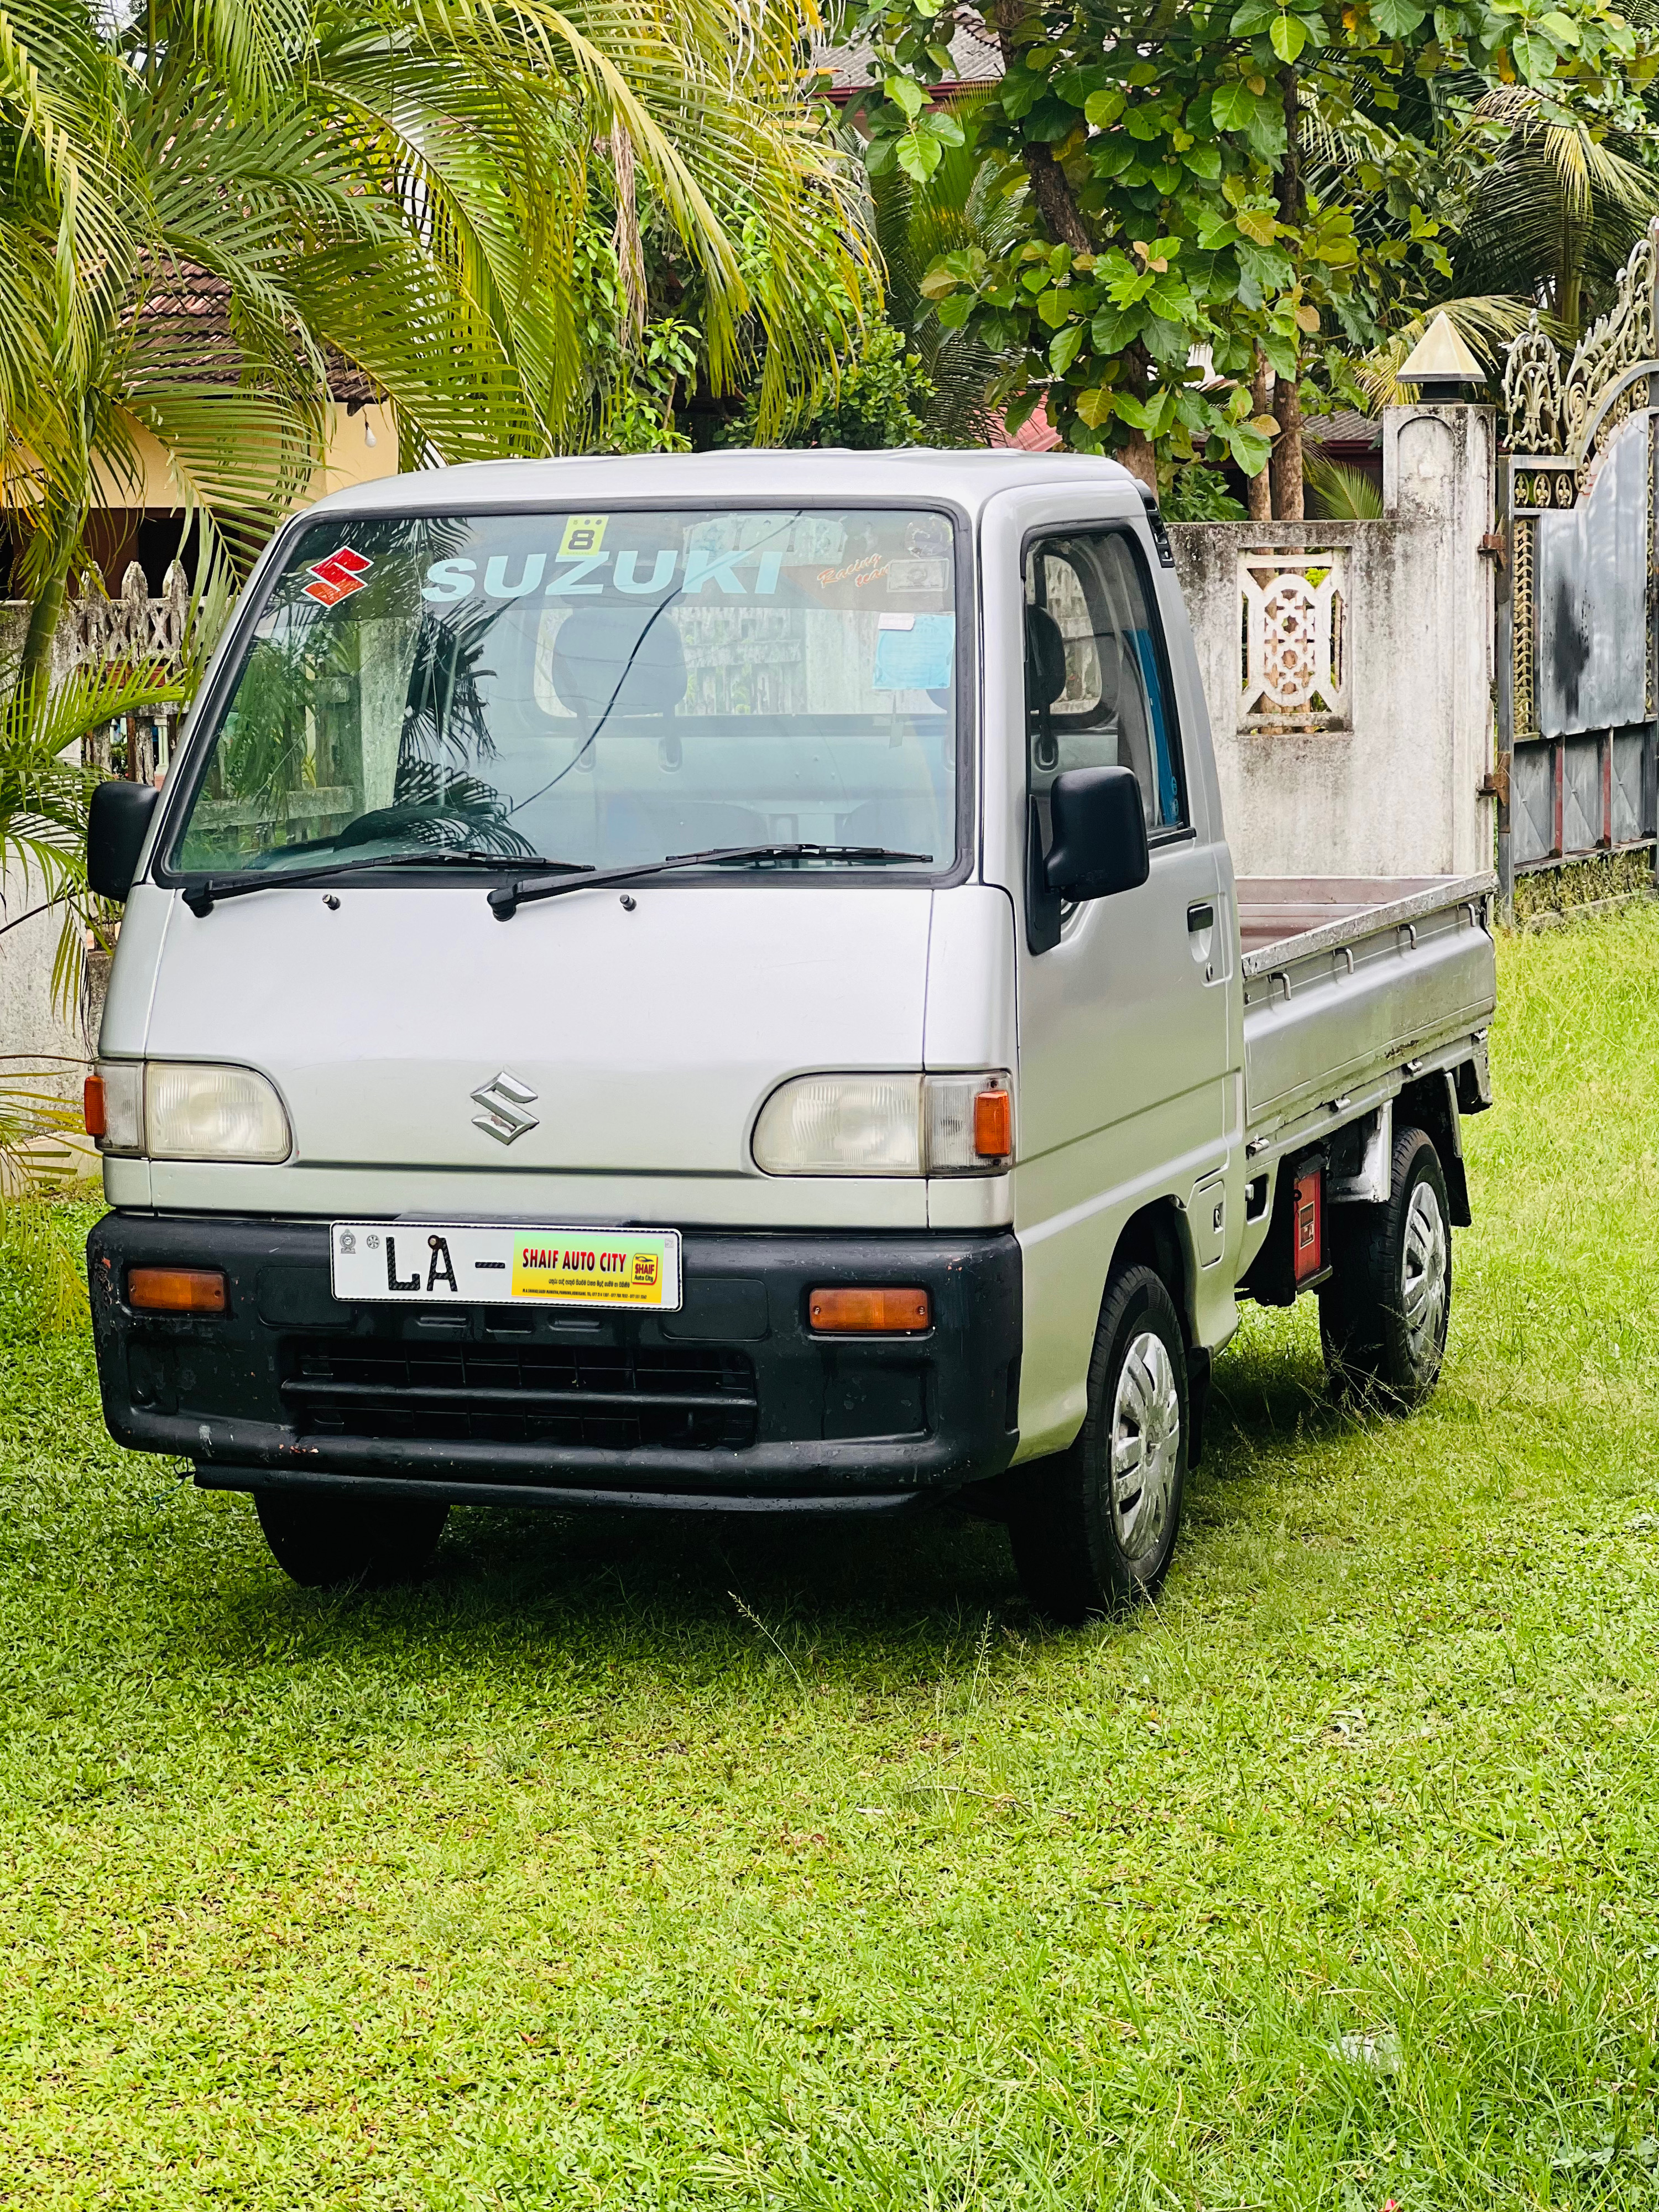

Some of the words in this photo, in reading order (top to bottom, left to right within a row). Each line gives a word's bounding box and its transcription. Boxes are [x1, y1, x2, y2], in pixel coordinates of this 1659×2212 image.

[568, 529, 595, 550] 8
[421, 550, 782, 602] SUZUKI
[817, 553, 882, 588] Racing
[523, 1248, 559, 1269] SHAIF
[562, 1250, 595, 1271] AUTO
[600, 1252, 627, 1272] CITY
[634, 1264, 655, 1275] SHAIF
